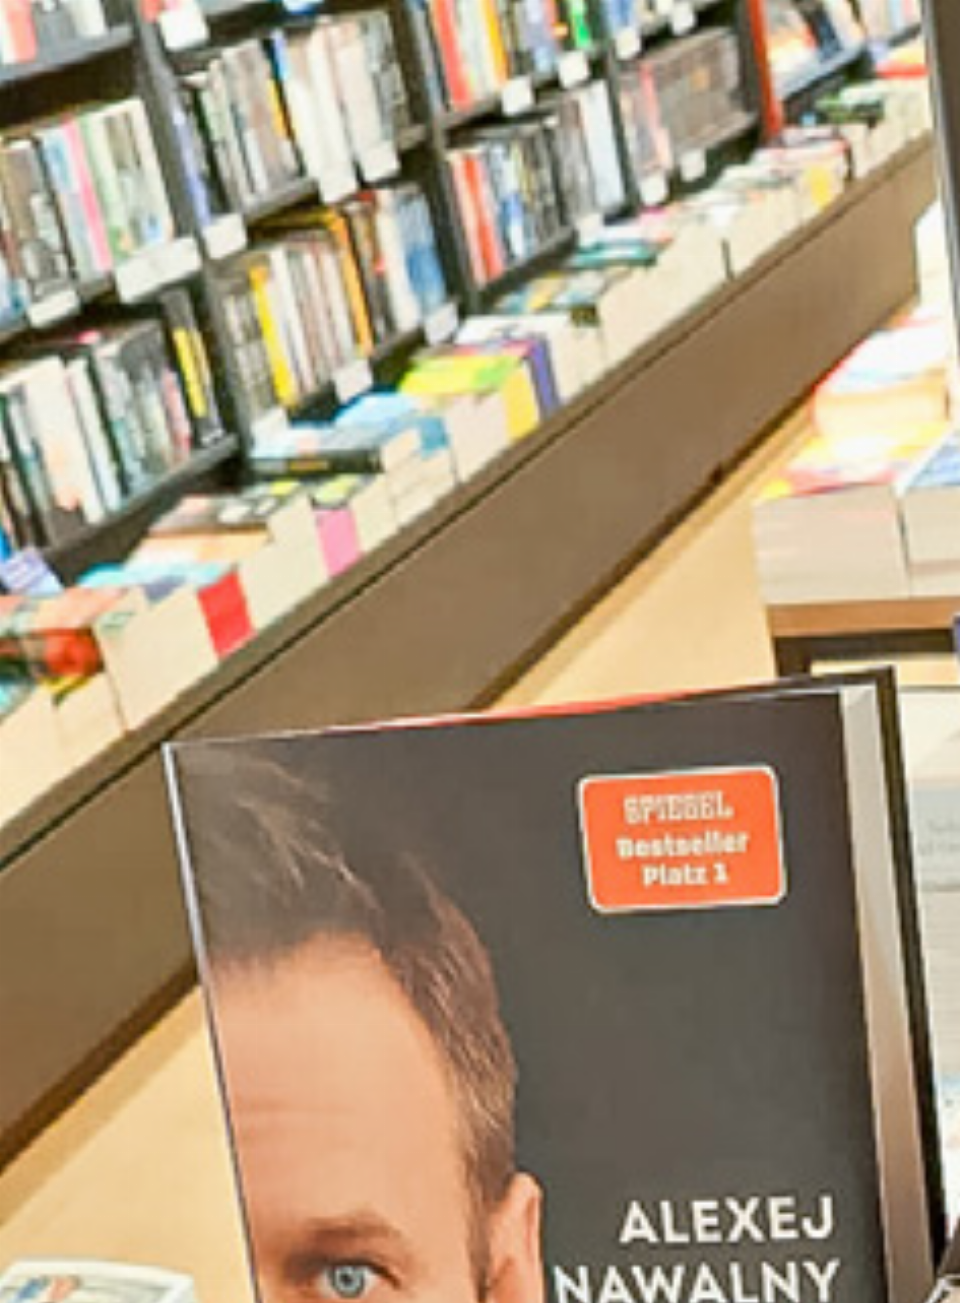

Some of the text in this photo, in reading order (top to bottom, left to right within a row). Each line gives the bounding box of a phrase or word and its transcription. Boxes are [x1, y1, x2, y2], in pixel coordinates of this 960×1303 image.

[616, 830, 748, 858] Bestseller
[642, 862, 728, 888] Platz 1
[620, 1196, 834, 1244] ALEXEJ
